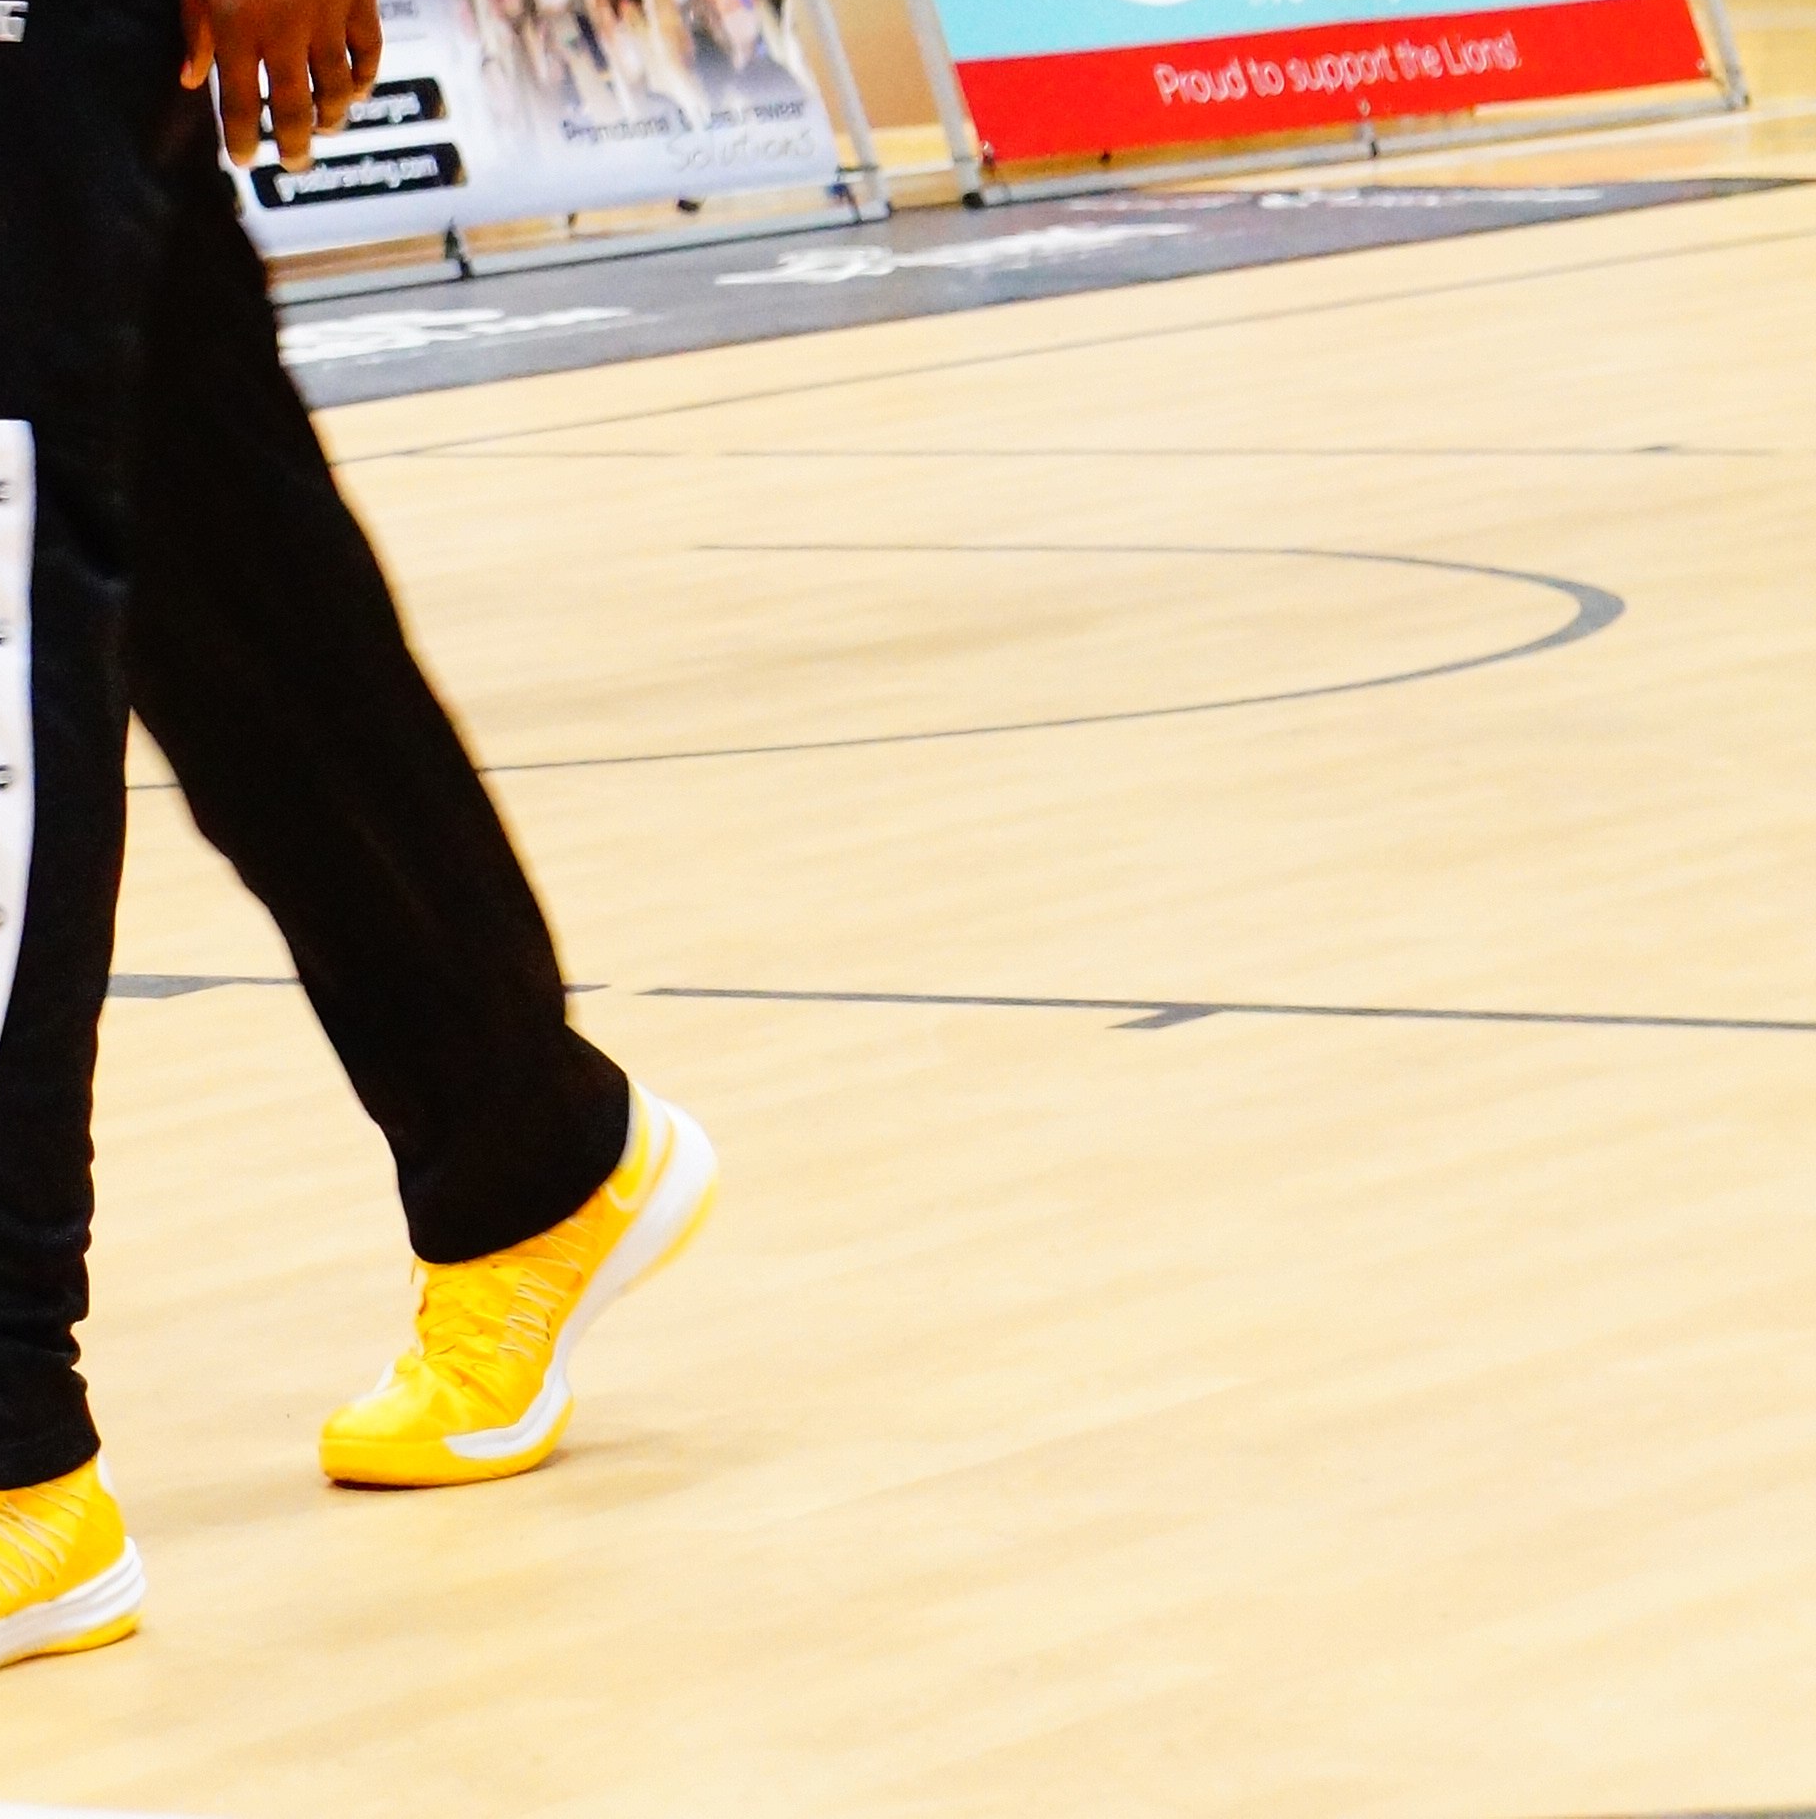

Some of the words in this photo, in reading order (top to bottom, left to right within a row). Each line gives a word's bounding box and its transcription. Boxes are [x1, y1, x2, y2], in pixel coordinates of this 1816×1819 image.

[1152, 57, 1248, 106] Proud
[1247, 55, 1286, 98] to
[1286, 42, 1398, 96] support
[1394, 37, 1444, 80] the
